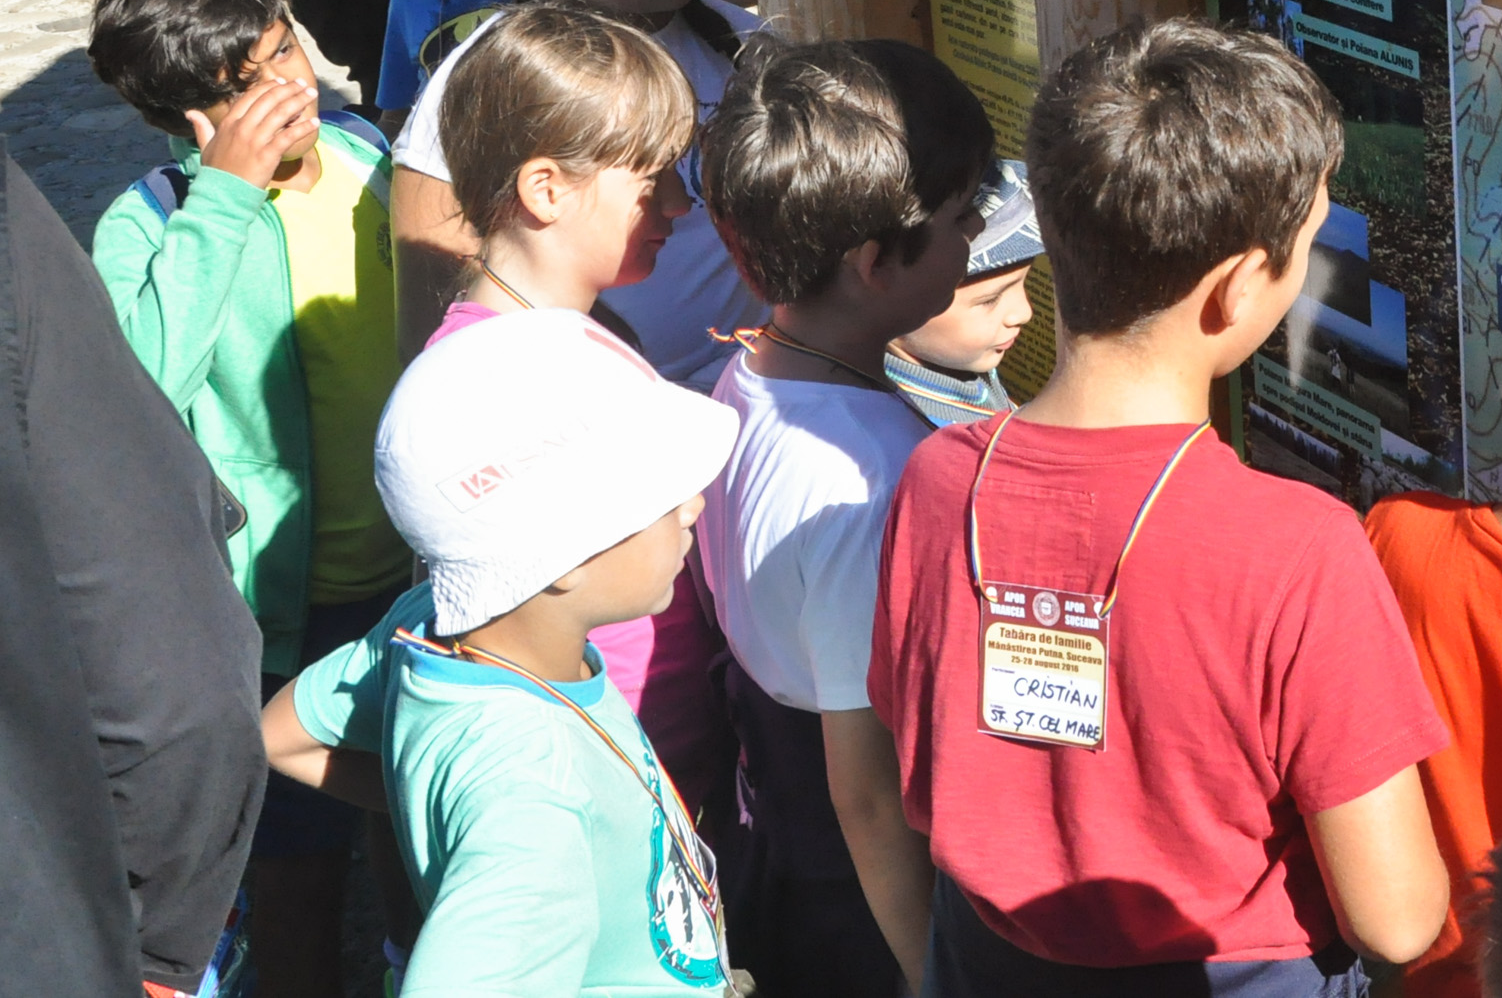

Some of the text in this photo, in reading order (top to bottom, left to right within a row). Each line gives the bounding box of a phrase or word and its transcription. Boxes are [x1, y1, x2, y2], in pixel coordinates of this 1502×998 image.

[1039, 633, 1051, 645] de
[1054, 635, 1092, 651] familie
[1066, 652, 1102, 666] Suceava
[1013, 676, 1098, 710] CRISTIAN
